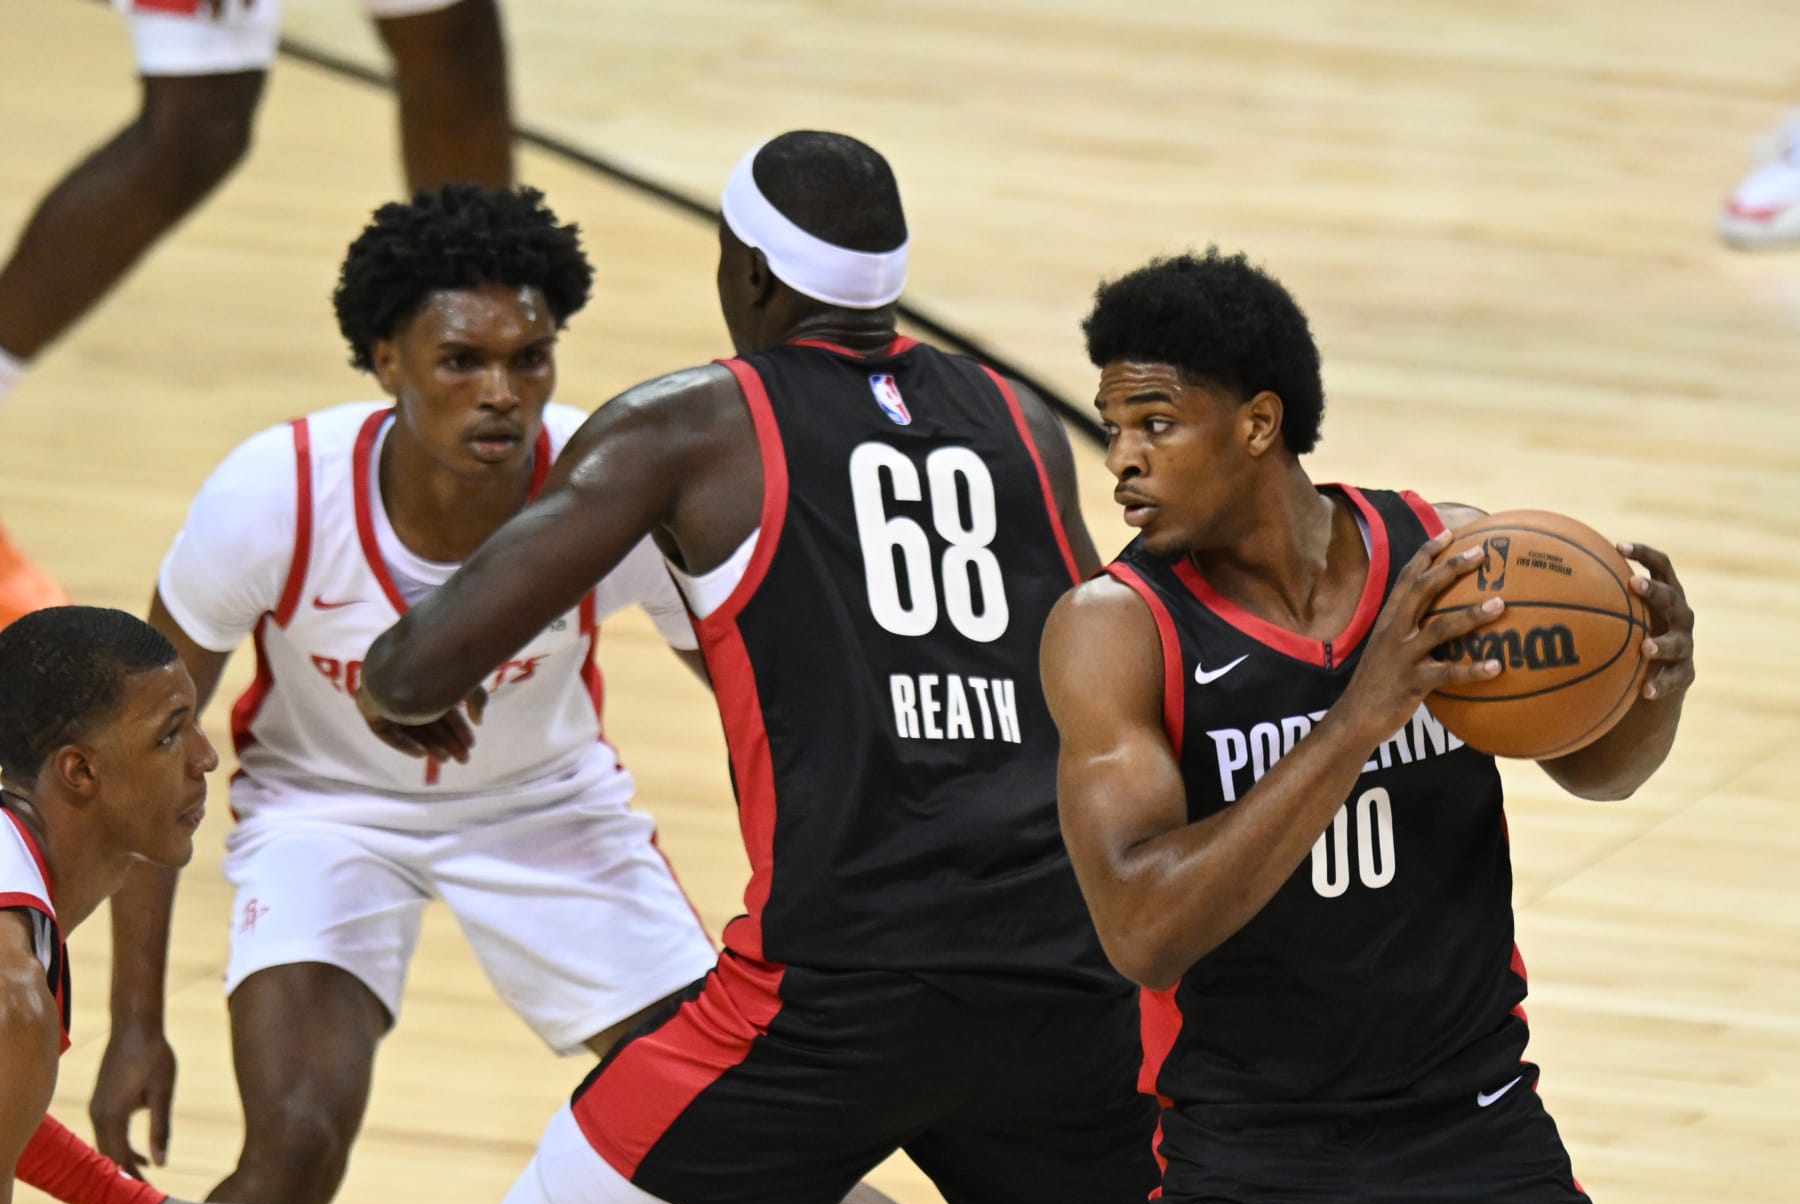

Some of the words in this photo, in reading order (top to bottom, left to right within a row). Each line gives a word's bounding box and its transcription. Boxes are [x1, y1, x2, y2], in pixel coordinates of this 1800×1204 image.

[849, 441, 1009, 643] 68
[889, 674, 1022, 743] REATH
[1312, 787, 1396, 898] 00
